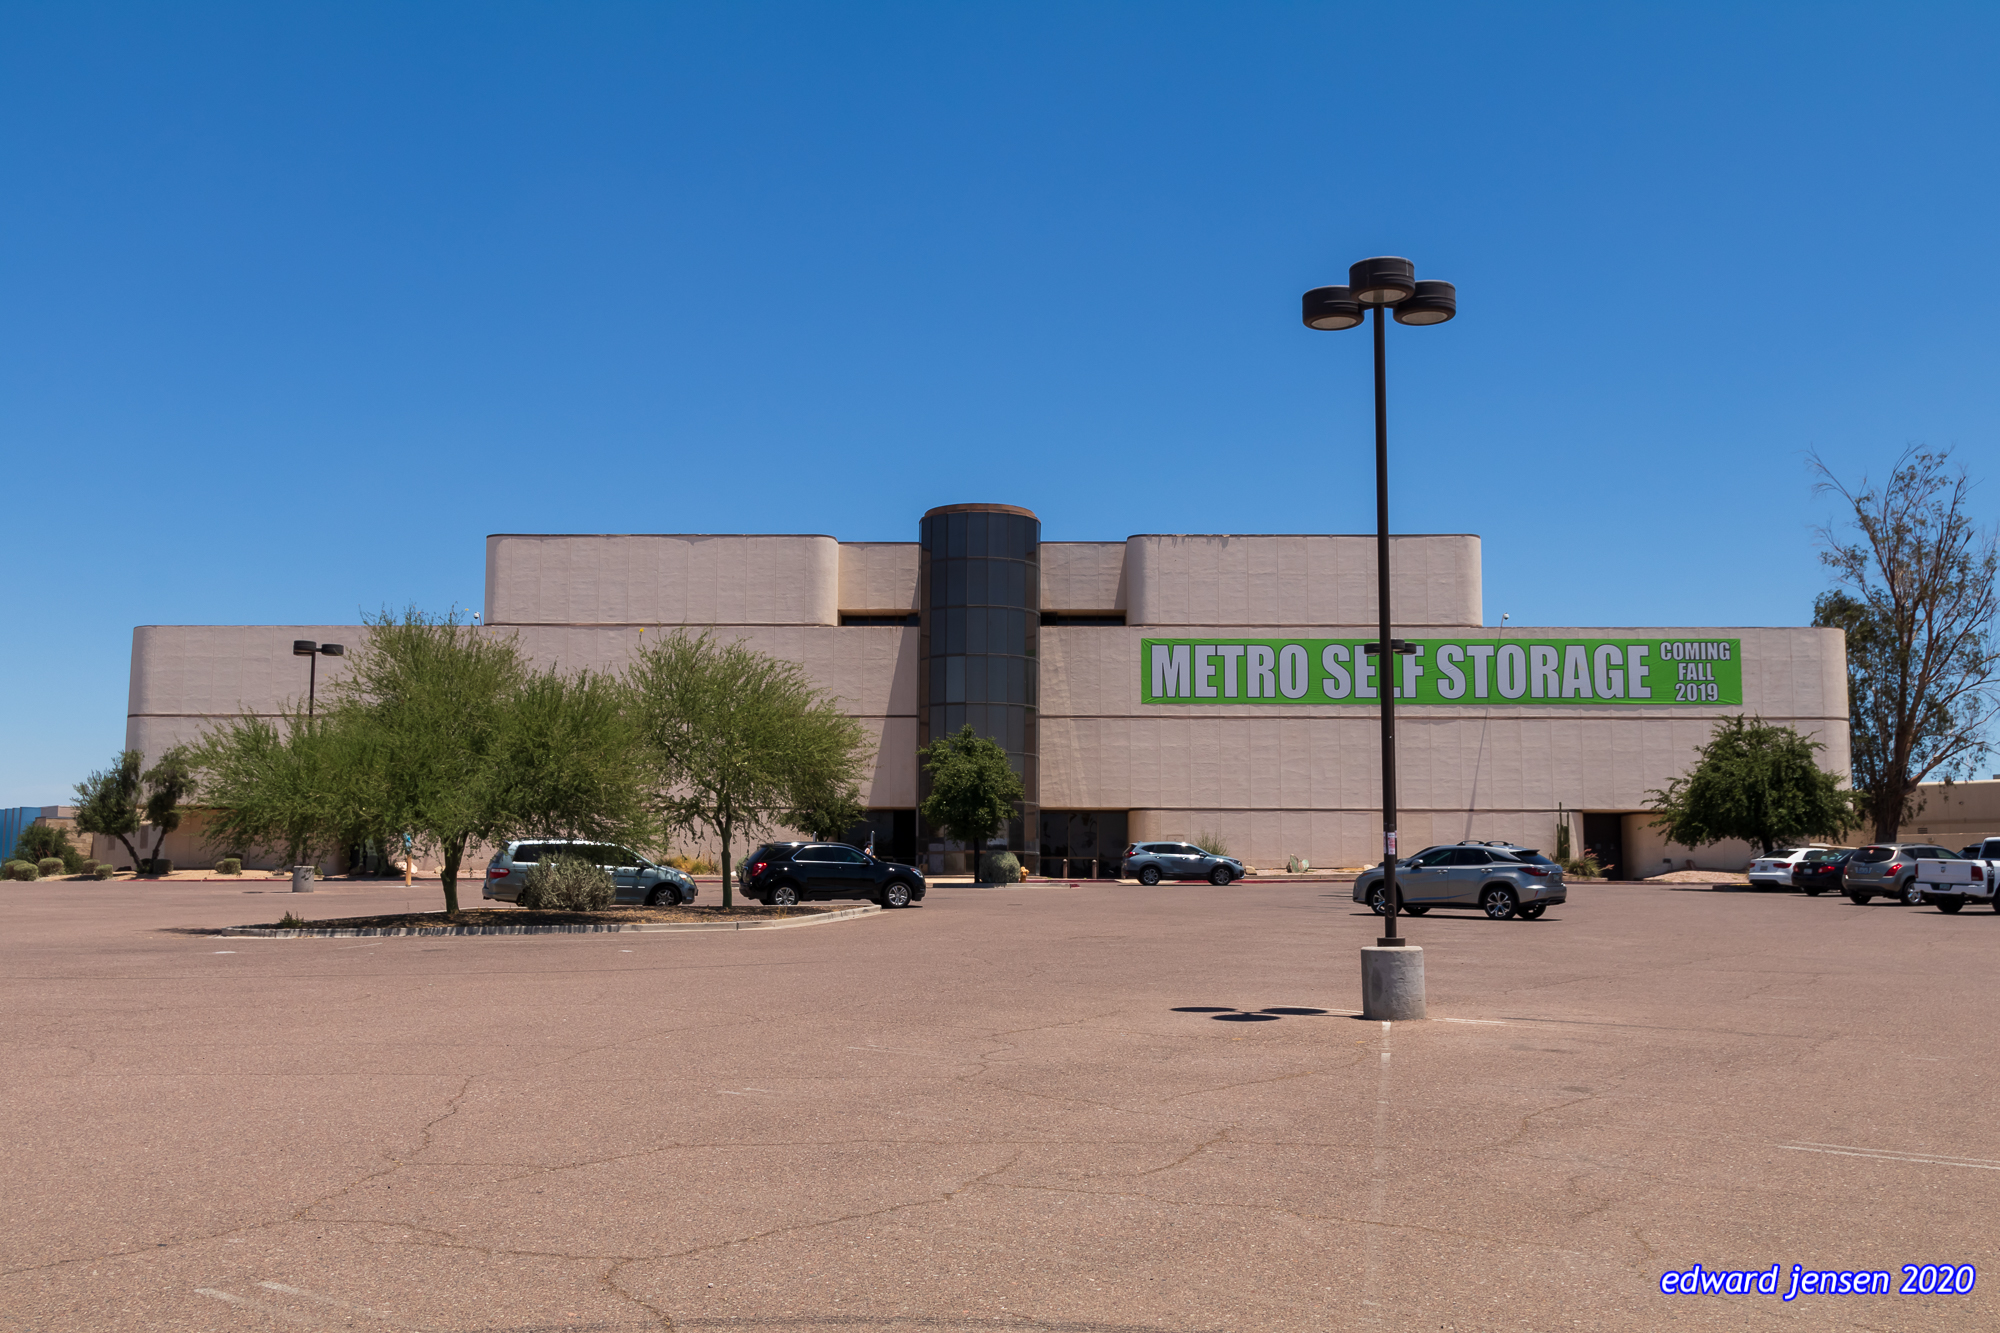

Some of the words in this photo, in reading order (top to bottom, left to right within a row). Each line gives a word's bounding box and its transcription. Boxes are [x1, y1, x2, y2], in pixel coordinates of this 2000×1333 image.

[1660, 641, 1731, 661] COMING
[1151, 643, 1309, 699] METRO
[1321, 643, 1425, 699] SEF
[1435, 643, 1652, 699] STORAGE
[1677, 662, 1715, 681] FALL
[1675, 682, 1719, 702] 2019
